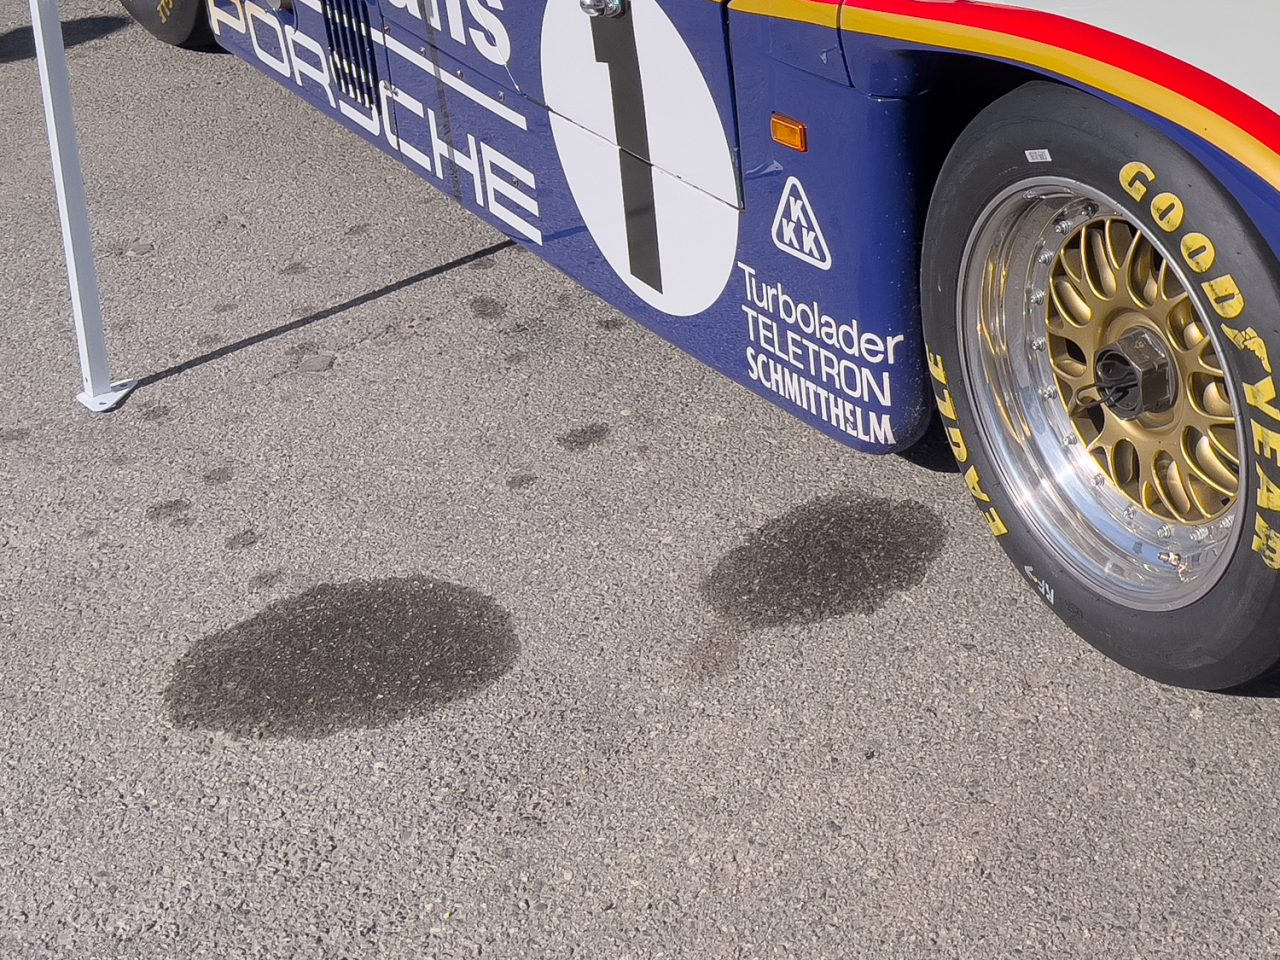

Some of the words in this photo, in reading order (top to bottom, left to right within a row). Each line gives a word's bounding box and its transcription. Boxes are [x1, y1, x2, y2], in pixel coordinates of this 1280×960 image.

[737, 261, 904, 365] Turbolader
[741, 305, 892, 406] TELETRON
[746, 346, 897, 445] SCHMITTHELM
